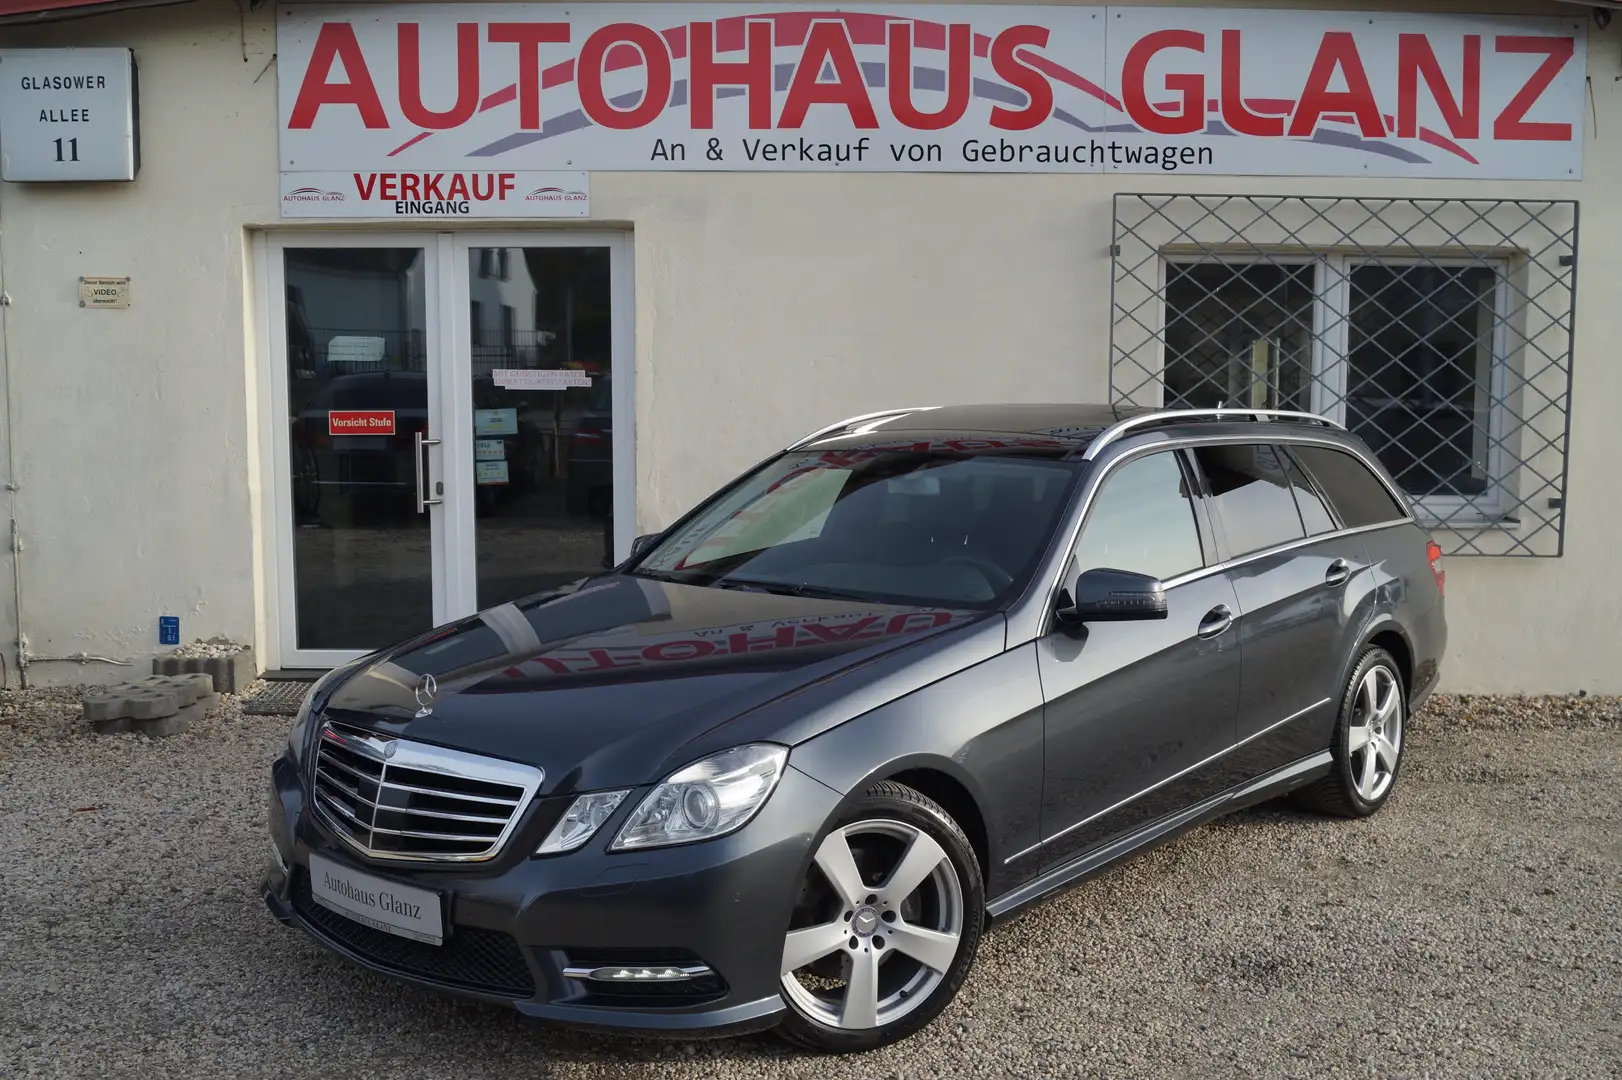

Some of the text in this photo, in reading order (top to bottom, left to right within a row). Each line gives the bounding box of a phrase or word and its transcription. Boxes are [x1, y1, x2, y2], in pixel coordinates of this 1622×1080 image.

[21, 76, 106, 90] GLASOWER
[289, 22, 1573, 142] AUTOHAUS GLANZ
[39, 109, 90, 122] ALLEE
[52, 137, 81, 162] 11
[650, 138, 1214, 171] An & Verkauf von Gebrauchtwagen
[353, 173, 516, 201] VERKAUF
[395, 201, 470, 215] EINGANG
[93, 288, 117, 296] VIDEO
[332, 417, 392, 427] Vorsicht Stufe
[323, 871, 422, 920] Autohaus Glanz
